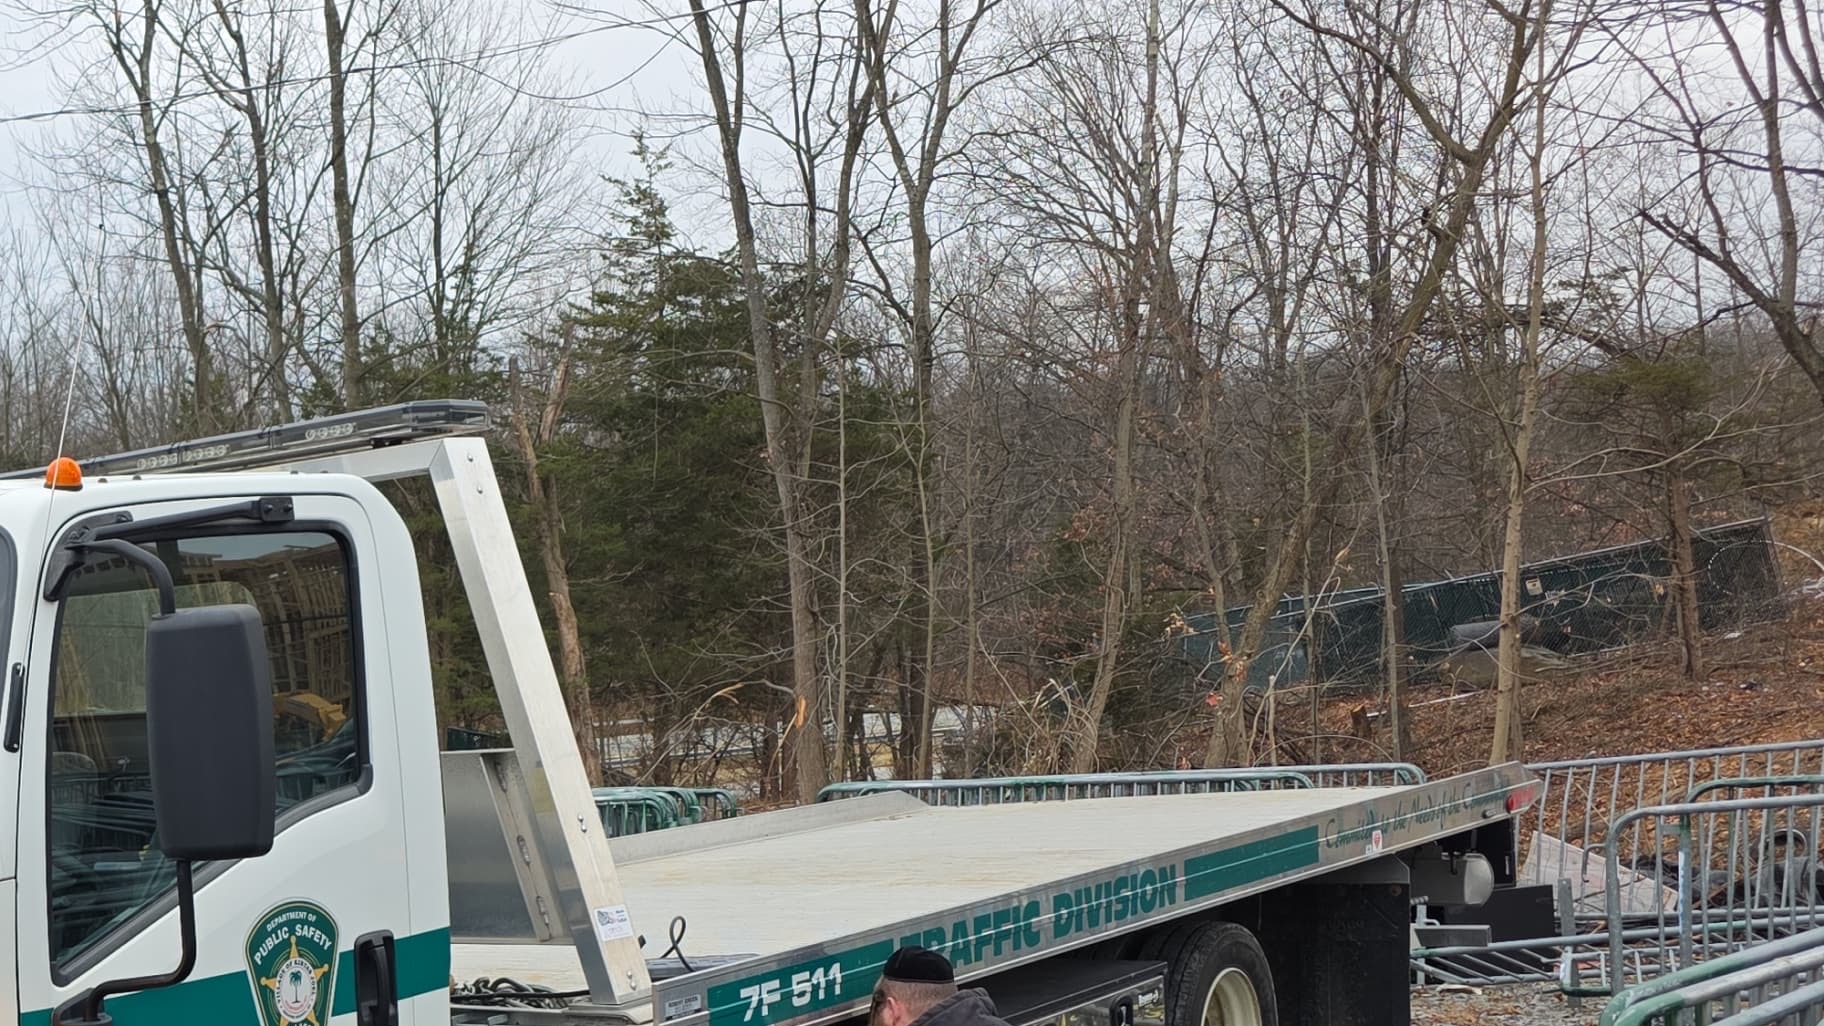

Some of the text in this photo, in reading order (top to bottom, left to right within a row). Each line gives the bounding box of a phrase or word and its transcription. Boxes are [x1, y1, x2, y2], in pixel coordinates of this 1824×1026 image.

[266, 911, 317, 932] DEPARTMENT OF
[1053, 864, 1176, 940] DIVISION
[254, 923, 332, 965] PUBLIC SAFETY
[739, 962, 842, 1022] 7F 511
